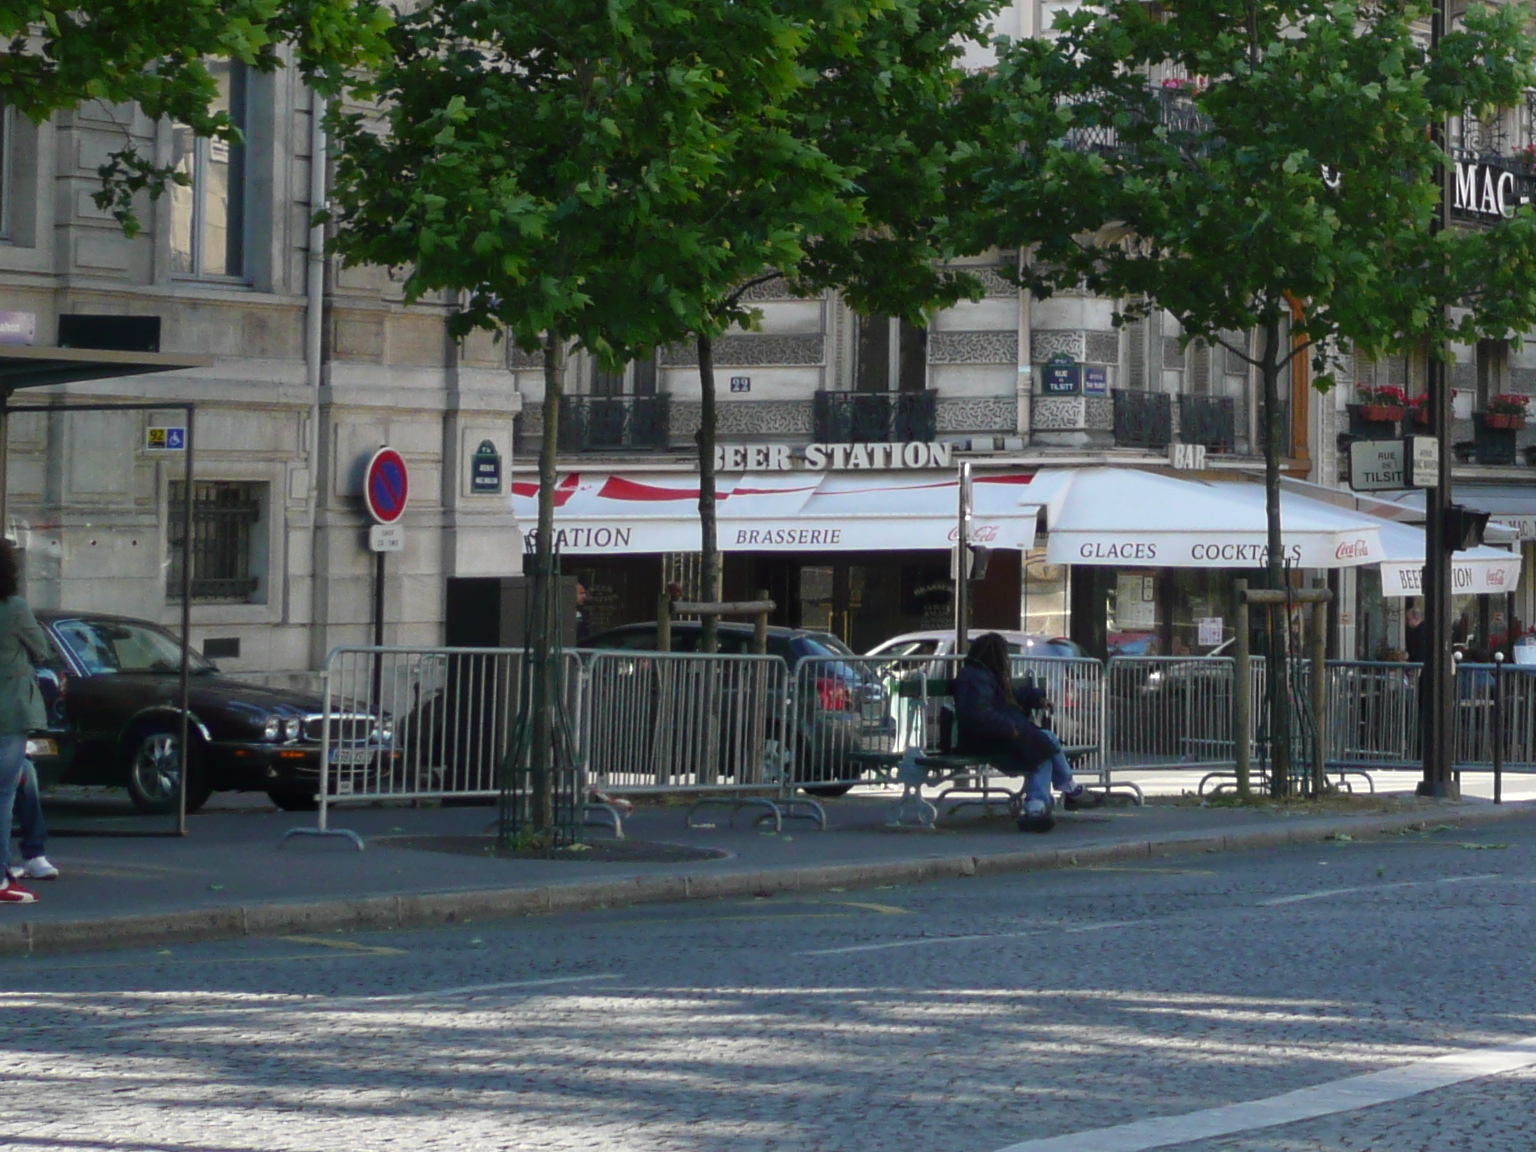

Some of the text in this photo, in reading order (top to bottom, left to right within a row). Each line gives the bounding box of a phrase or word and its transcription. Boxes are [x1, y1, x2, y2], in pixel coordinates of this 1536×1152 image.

[1055, 370, 1068, 378] RUE
[732, 378, 749, 392] 22
[1050, 383, 1074, 391] TILSITT
[150, 430, 164, 441] 92
[714, 441, 953, 471] BEER STATION
[1174, 444, 1206, 470] BAR
[1378, 451, 1396, 460] RUE
[736, 529, 841, 545] BRASSERIE
[1080, 543, 1157, 559] GLACES
